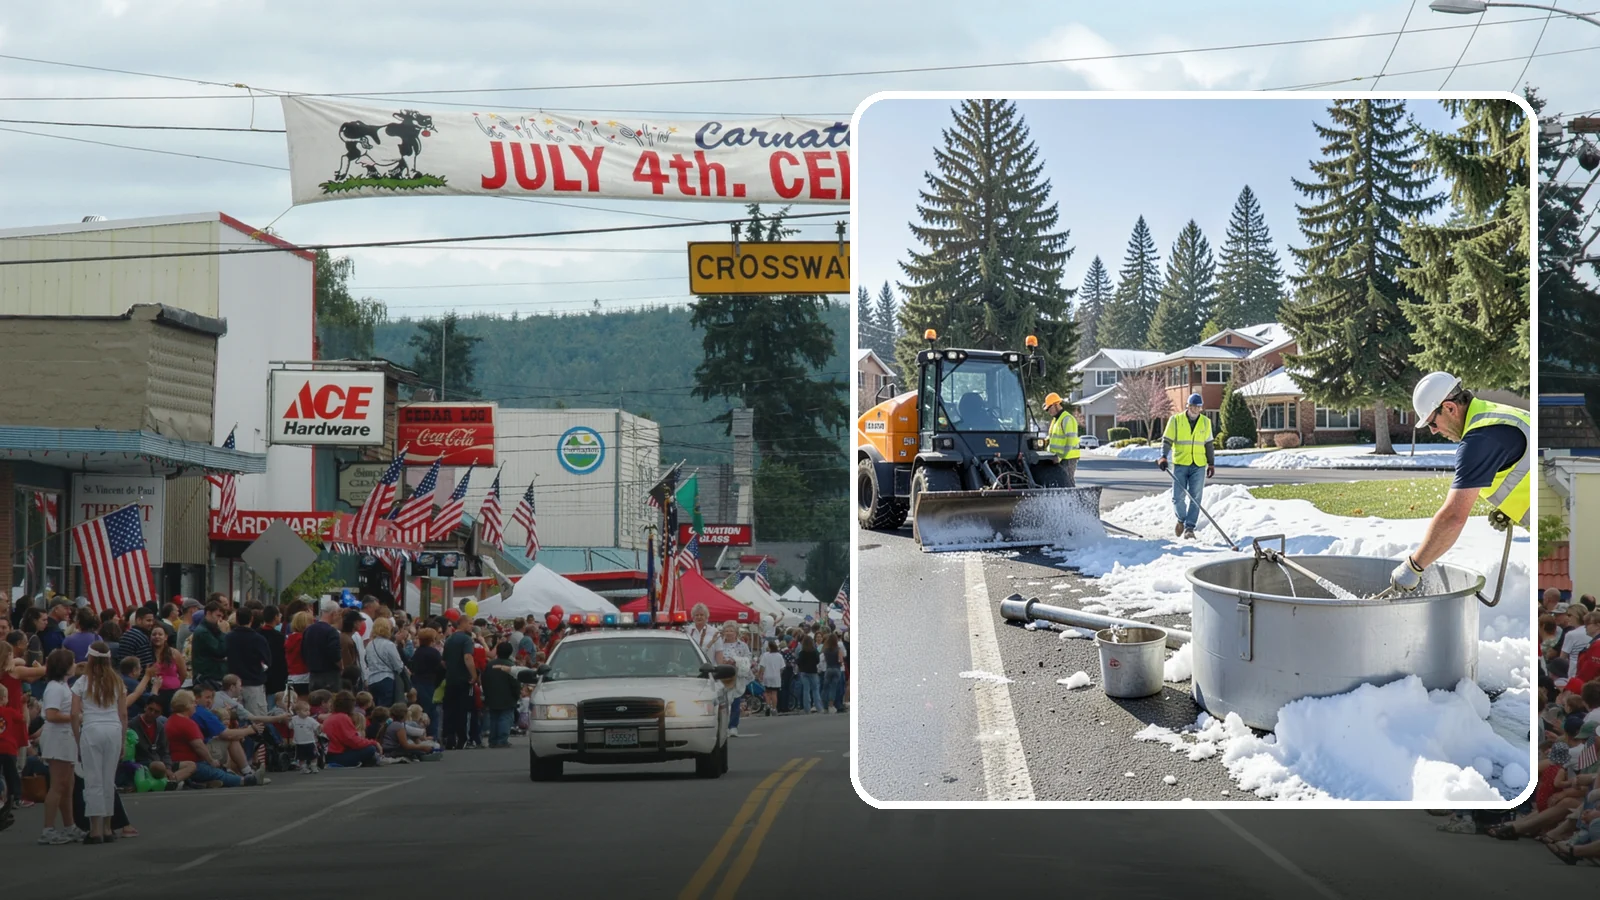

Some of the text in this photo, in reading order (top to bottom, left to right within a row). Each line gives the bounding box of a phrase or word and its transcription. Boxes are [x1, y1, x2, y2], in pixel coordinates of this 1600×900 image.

[481, 140, 605, 193] JULY
[632, 150, 746, 198] 4th.
[697, 254, 850, 280] CROSSWA
[283, 380, 374, 420] ACE
[406, 409, 485, 422] CEDAR LOG
[283, 421, 371, 437] Hardware
[416, 428, 477, 447] Coca-Cola
[83, 484, 155, 495] St. Vincent de Paul
[688, 526, 741, 535] CRNATION
[699, 535, 730, 543] GLASS
